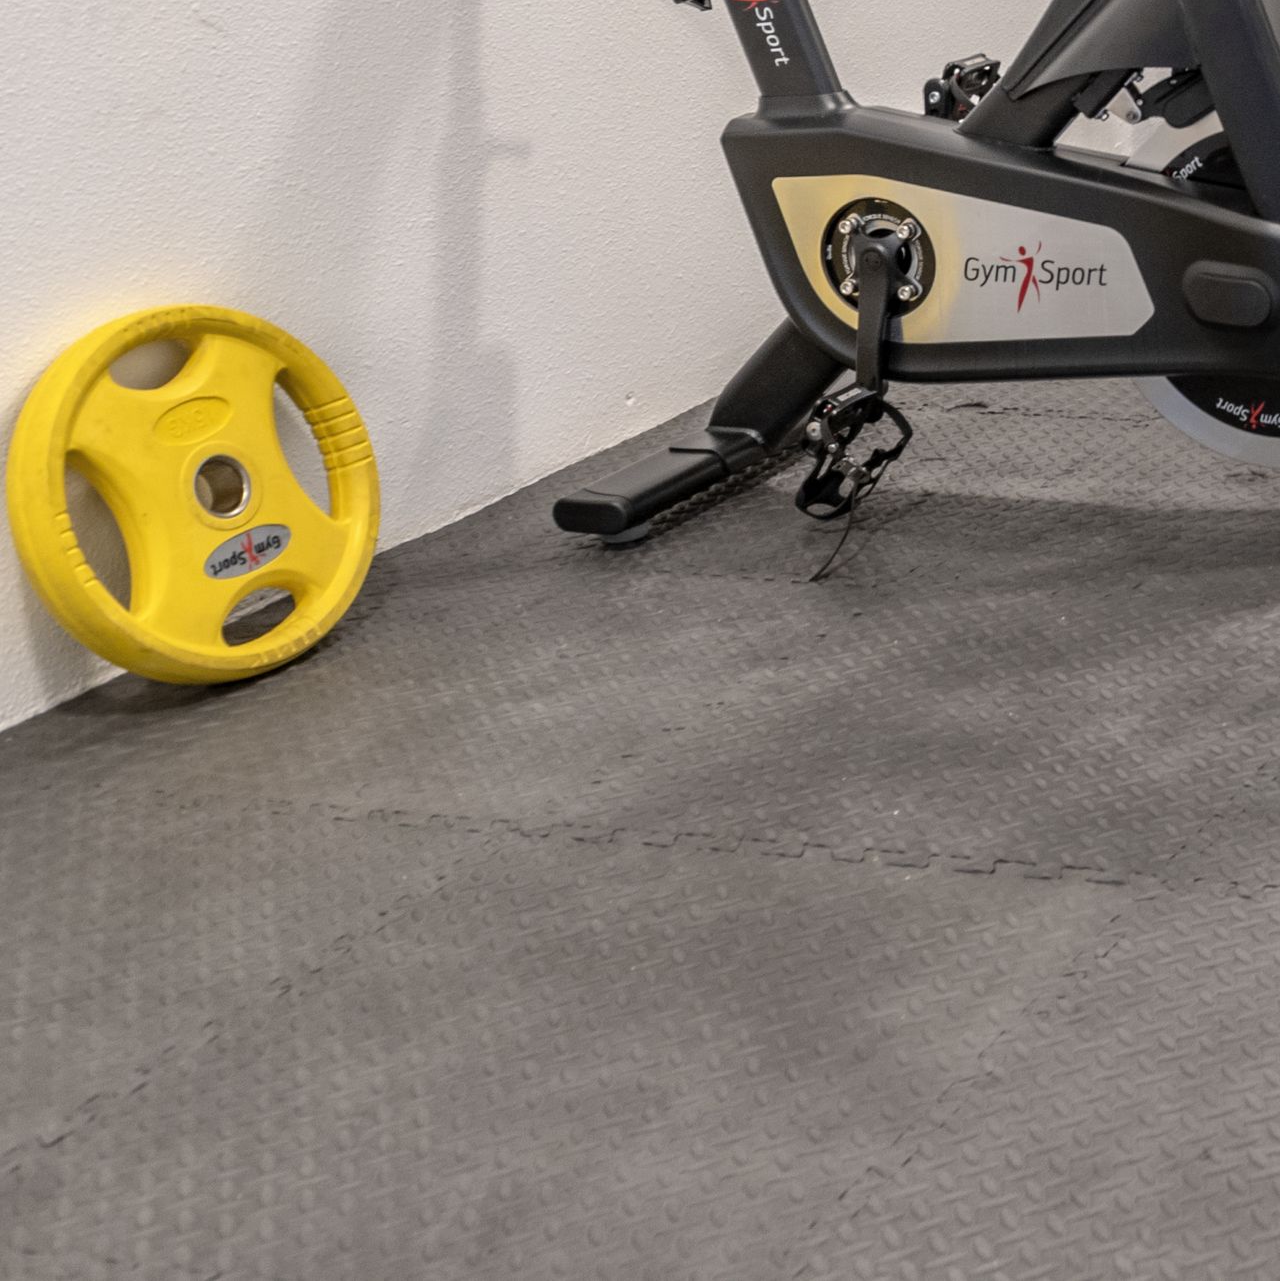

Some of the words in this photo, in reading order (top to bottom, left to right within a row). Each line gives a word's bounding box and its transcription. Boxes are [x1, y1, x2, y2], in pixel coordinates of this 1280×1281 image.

[755, 6, 790, 67] Sport
[1172, 156, 1204, 182] Sport
[964, 257, 1016, 288] Gym
[1039, 260, 1107, 291] Sport
[1215, 397, 1250, 422] Sport
[254, 535, 281, 555] Gym
[210, 550, 248, 576] Sport
